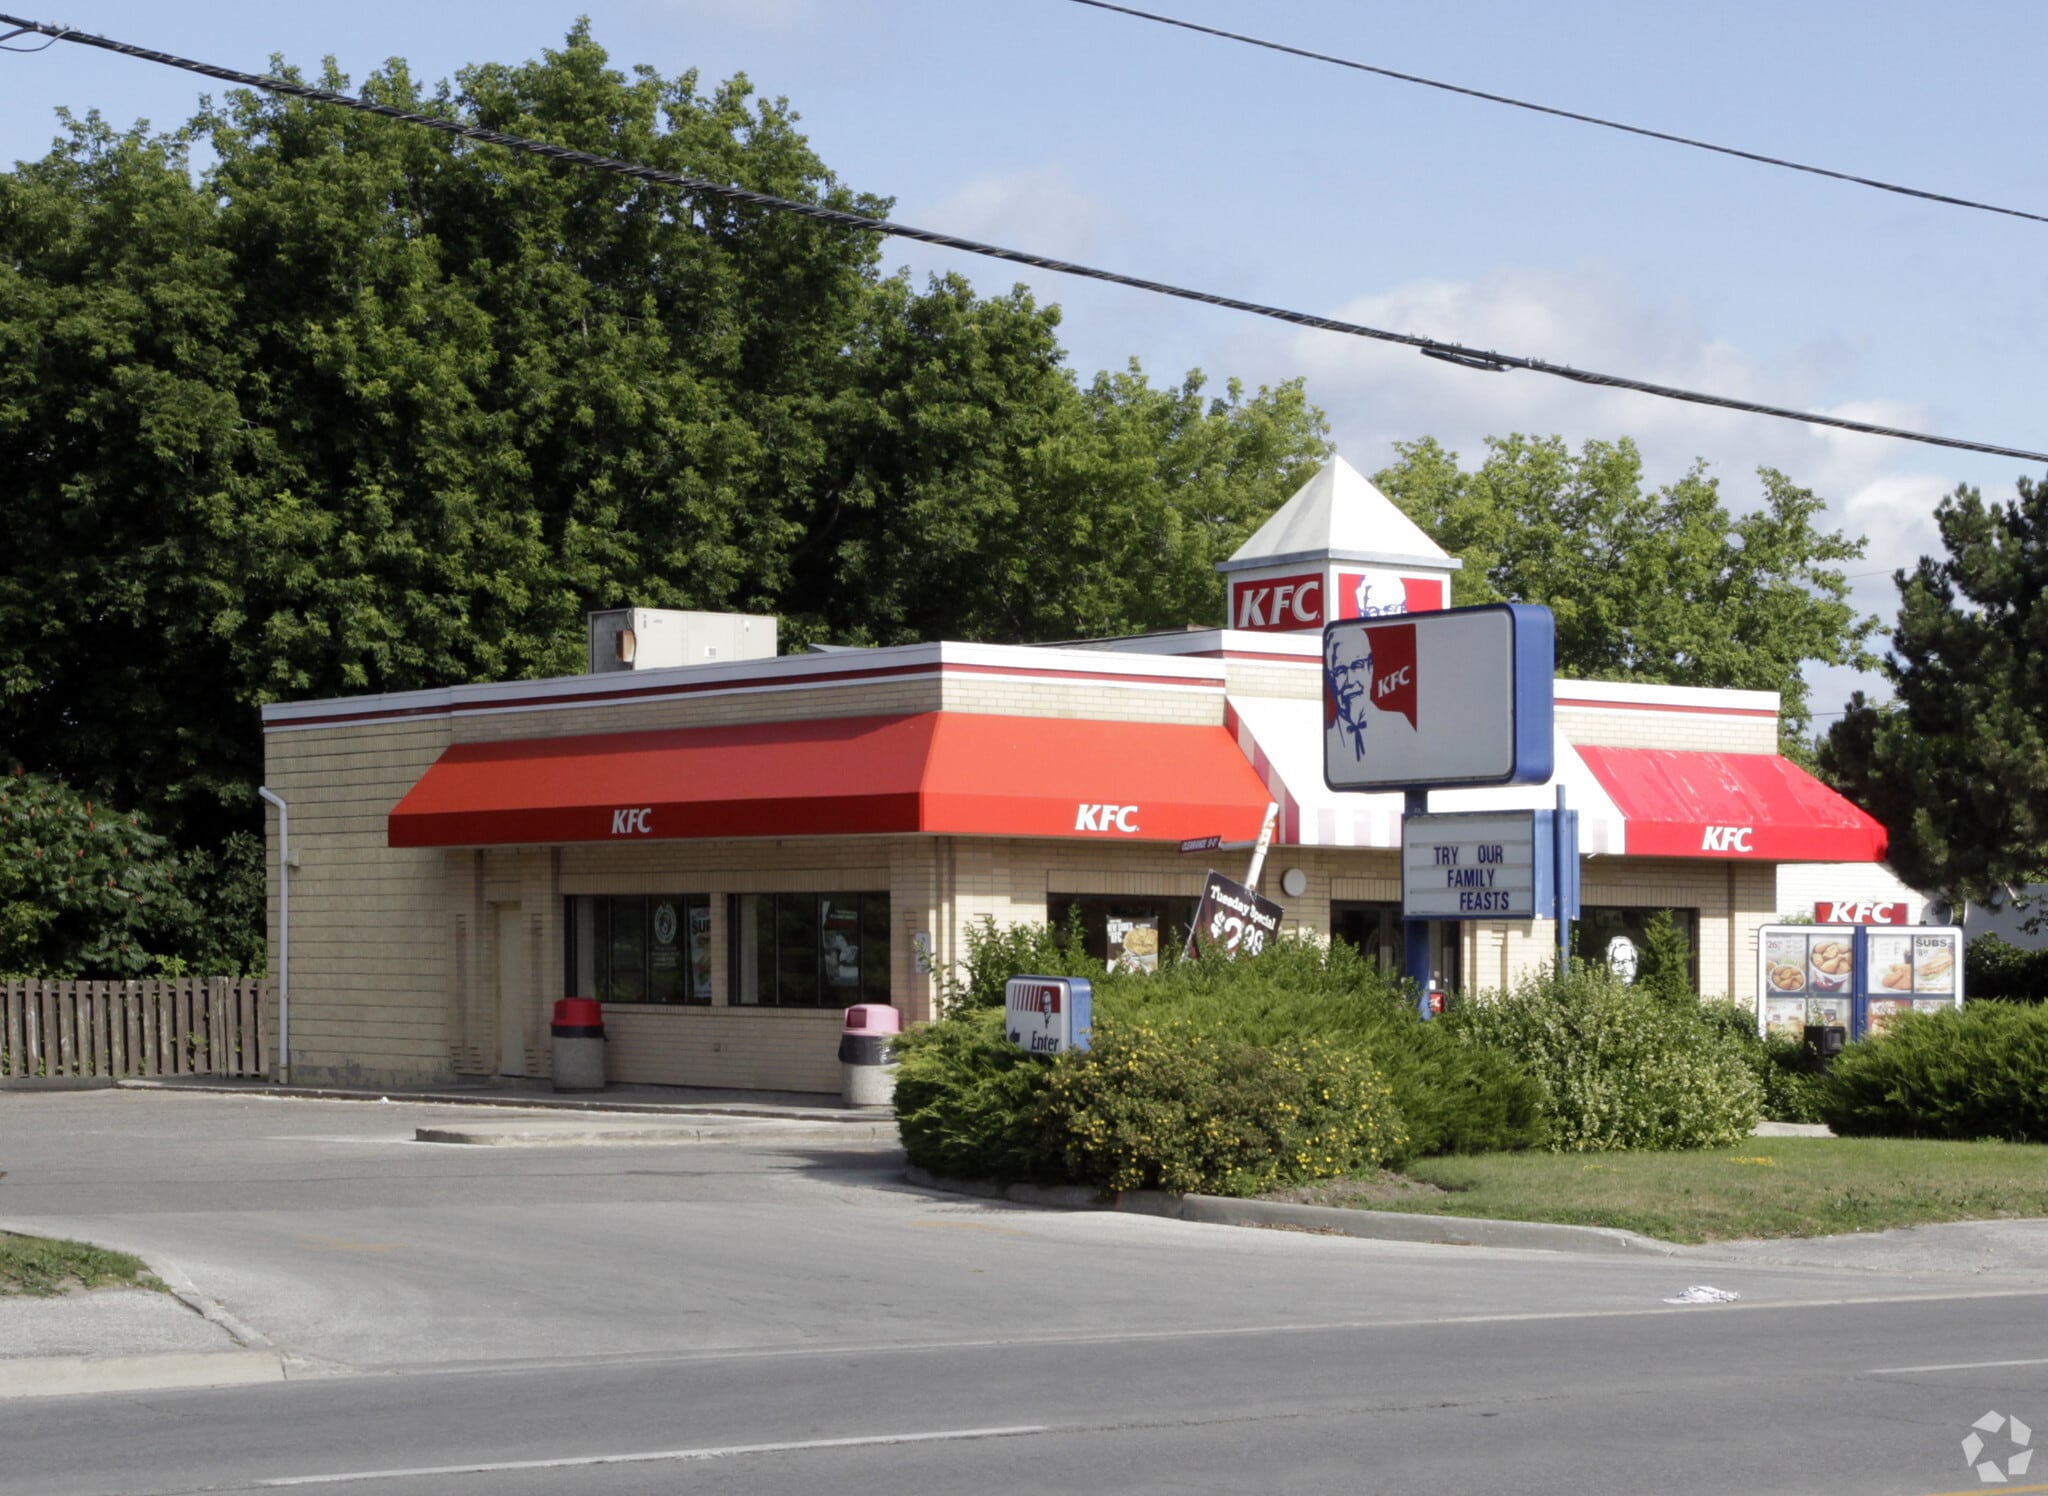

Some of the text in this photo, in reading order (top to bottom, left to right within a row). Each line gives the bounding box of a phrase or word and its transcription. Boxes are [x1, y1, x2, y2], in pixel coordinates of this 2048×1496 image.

[1238, 581, 1319, 628] KFC
[1377, 665, 1411, 698] KFC
[611, 807, 652, 834] KFC
[1074, 804, 1139, 832] KFC
[1701, 826, 1753, 852] KFC
[1433, 845, 1503, 865] TRY OUR
[1447, 868, 1495, 888] FAMILY
[1210, 884, 1276, 930] Tuesday Special
[1460, 891, 1509, 911] FEASTS
[1828, 901, 1894, 924] KFC
[1915, 938, 1948, 948] SUBS
[1031, 1030, 1059, 1052] Enter
